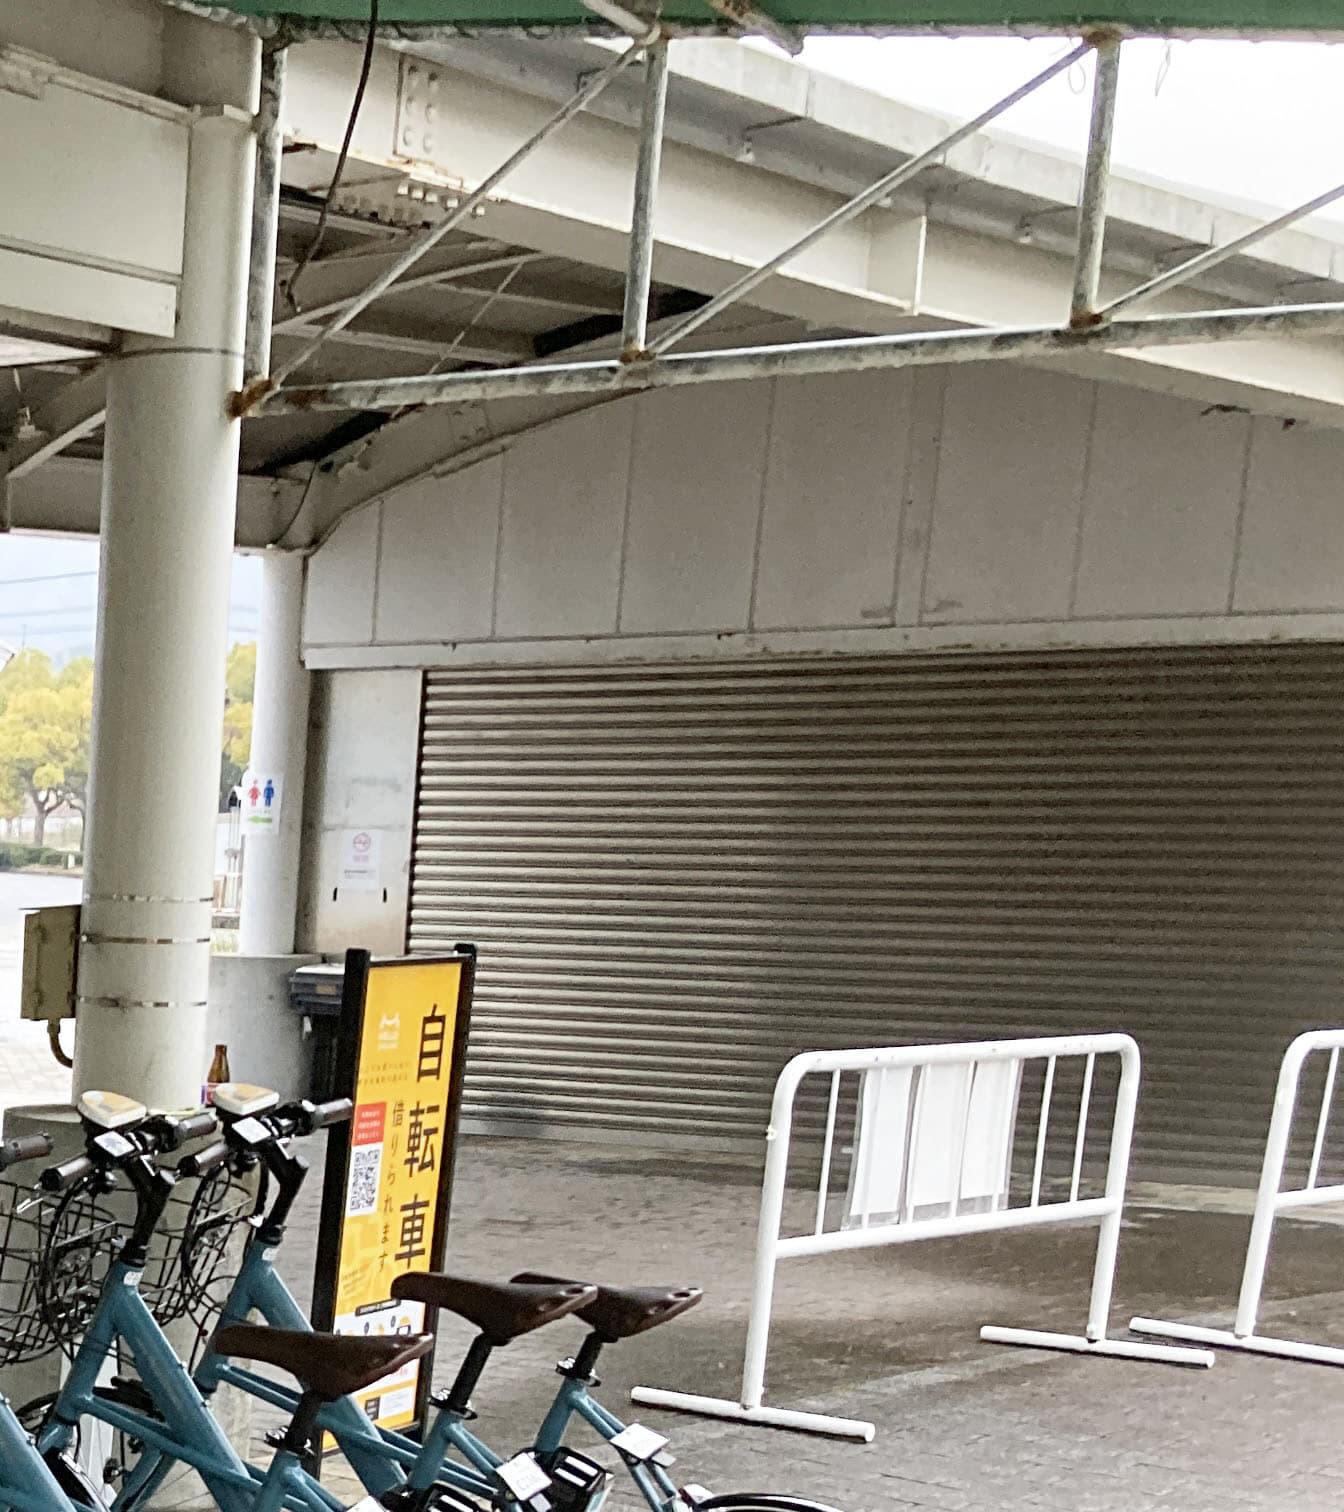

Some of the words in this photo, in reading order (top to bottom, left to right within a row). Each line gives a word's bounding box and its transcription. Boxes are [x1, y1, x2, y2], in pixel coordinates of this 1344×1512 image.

[378, 1100, 405, 1273] 借りられます
[395, 1003, 446, 1270] 自転車
